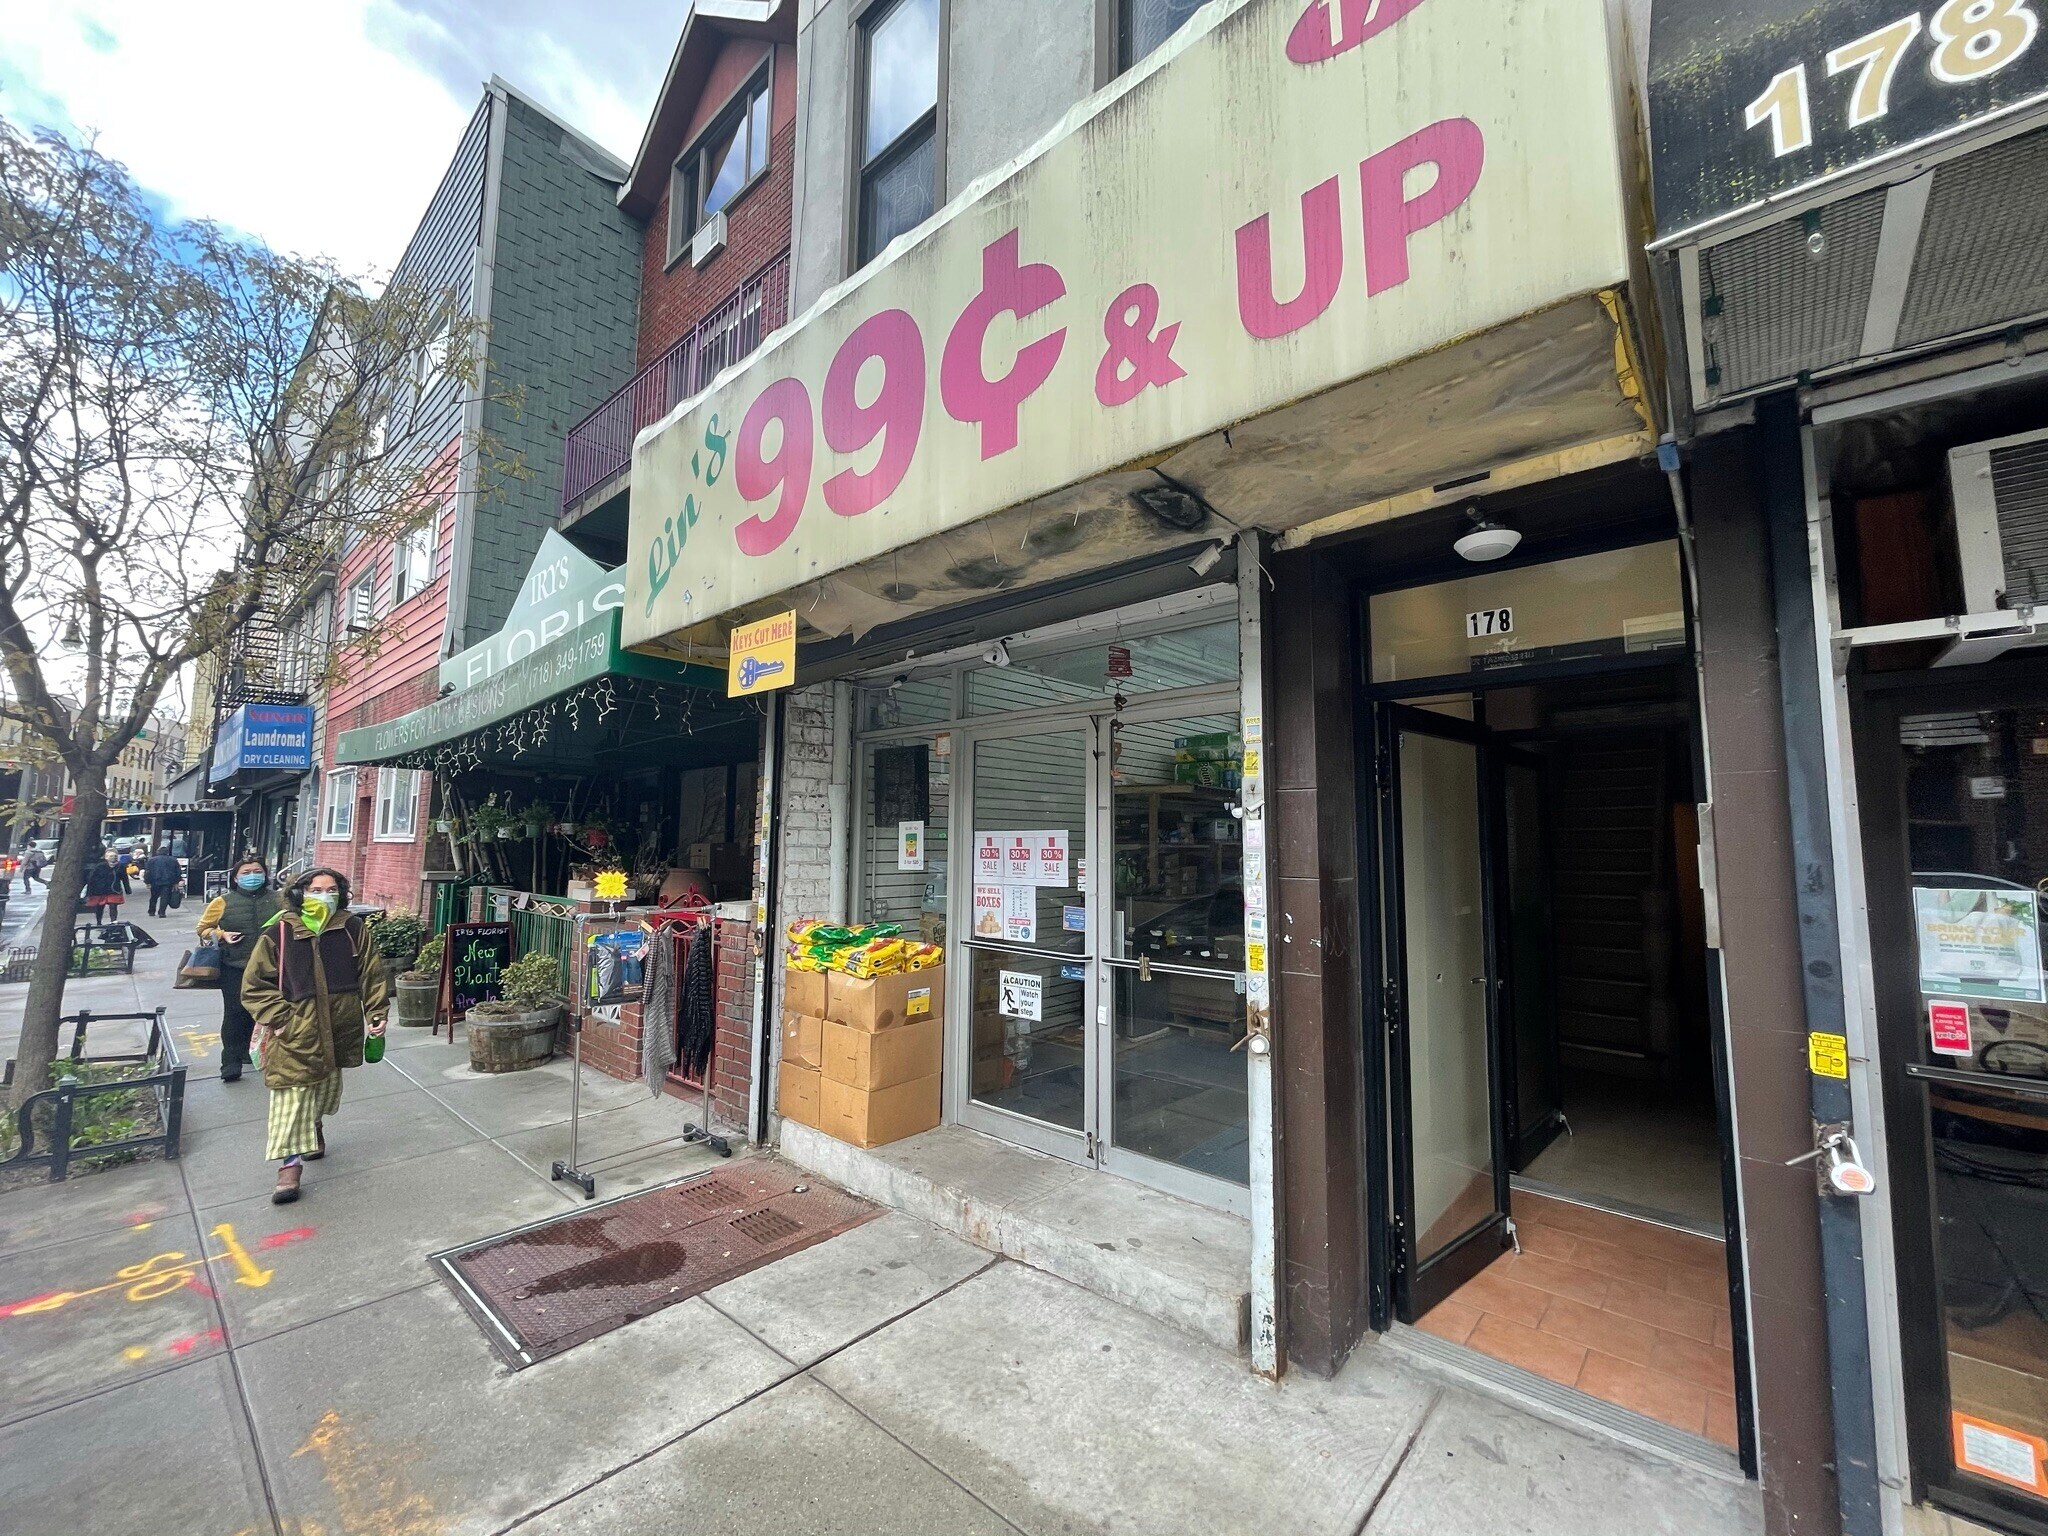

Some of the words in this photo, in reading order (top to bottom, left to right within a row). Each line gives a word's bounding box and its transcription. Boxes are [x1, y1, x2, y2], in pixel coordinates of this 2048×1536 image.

[1744, 0, 2039, 158] 178
[645, 413, 731, 619] Lin's
[735, 227, 1067, 557] 99¢
[1095, 283, 1188, 407] &
[1235, 117, 1484, 340] UP
[1470, 609, 1510, 636] 178
[733, 632, 752, 651] KEYS
[754, 627, 770, 645] CUT
[771, 620, 792, 640] HERE
[375, 722, 408, 751] FLOWERS
[409, 717, 426, 742] FOR
[428, 708, 443, 737] ALL
[528, 658, 553, 692] (718)
[555, 632, 605, 676] 349-1759
[244, 728, 306, 748] Laundromat
[243, 754, 261, 764] DRY
[263, 754, 305, 765] CLEANING
[981, 849, 990, 858] 30
[1011, 850, 1020, 859] 30
[1042, 850, 1052, 859] 30
[983, 861, 997, 870] SALE
[1012, 862, 1027, 871] SALE
[1044, 862, 1060, 872] SALE
[976, 896, 1001, 908] BOXES
[477, 927, 509, 936] FLORIST
[463, 939, 497, 962] New
[1010, 977, 1040, 989] CAUTION
[1020, 989, 1039, 999] Watch
[456, 992, 476, 1009] Are
[1020, 1008, 1034, 1016] step
